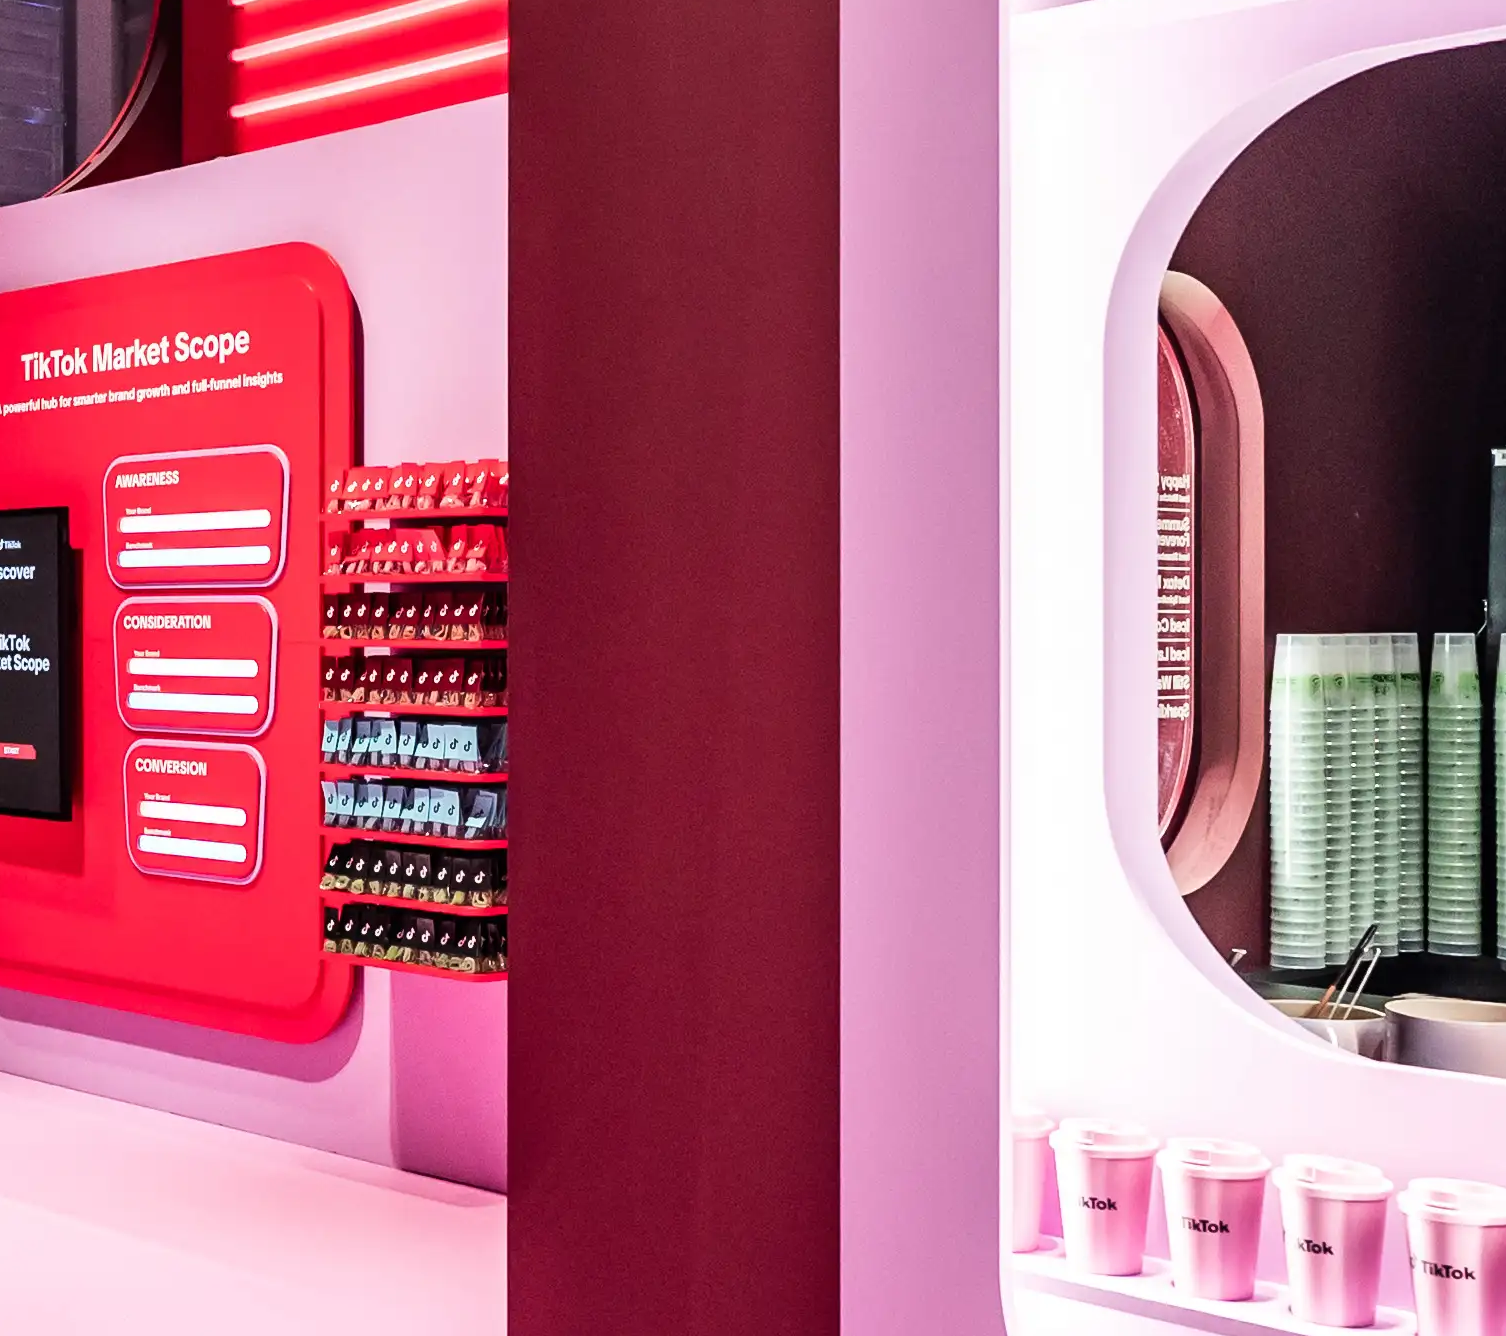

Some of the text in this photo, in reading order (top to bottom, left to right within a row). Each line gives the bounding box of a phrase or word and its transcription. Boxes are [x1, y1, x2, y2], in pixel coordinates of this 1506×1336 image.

[20, 330, 250, 382] TikTok Market Scope
[3, 398, 40, 416] powerful
[41, 396, 58, 410] hub
[59, 394, 72, 408] for
[73, 392, 107, 407] smarter
[109, 388, 136, 404] brand
[136, 383, 171, 403] growth
[172, 380, 191, 396] and
[192, 374, 241, 394] full-funnel
[243, 370, 284, 390] insights
[115, 470, 180, 489] AWARENESS
[4, 539, 22, 550] TikTok
[123, 615, 212, 630] CONSIDERATION
[14, 653, 50, 675] Scope
[135, 757, 207, 776] CONVERSION
[1421, 1259, 1476, 1281] TikTok
